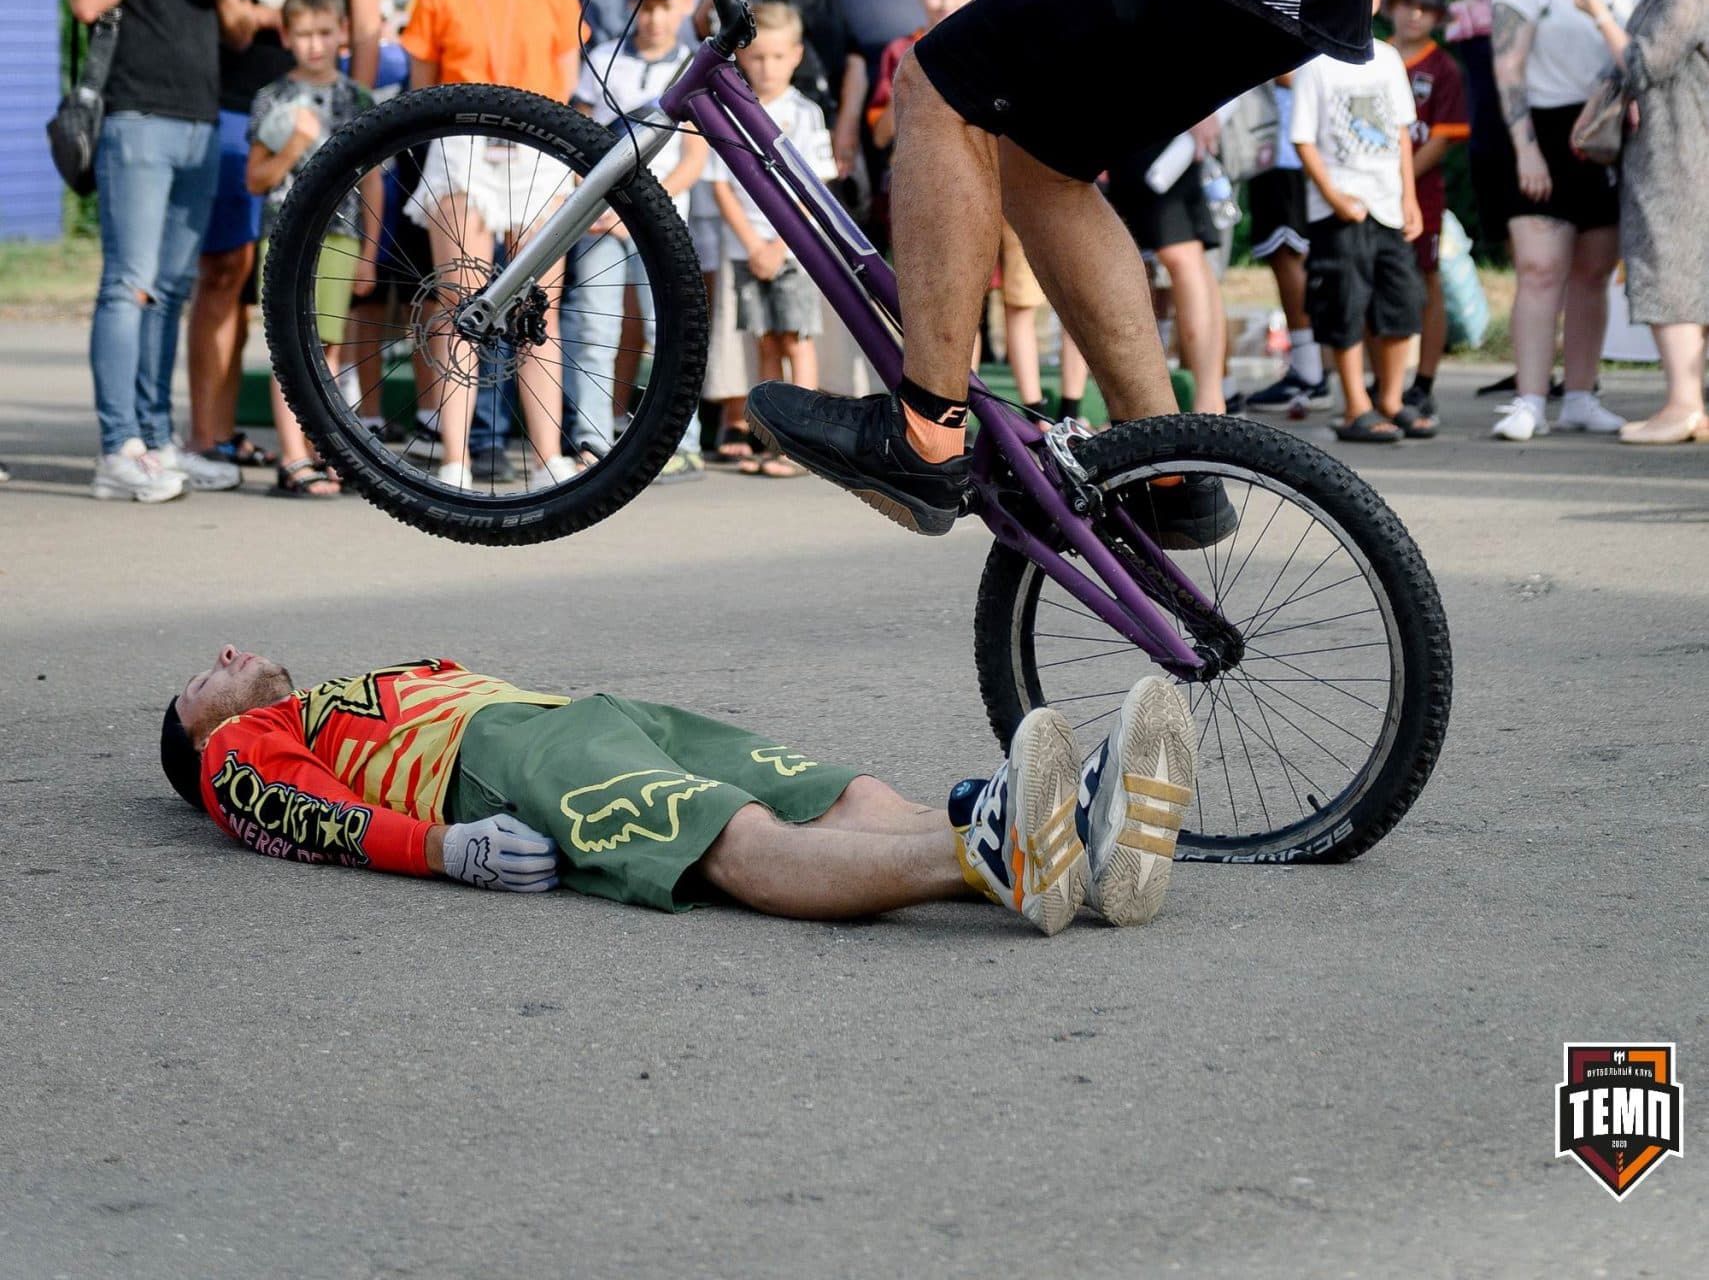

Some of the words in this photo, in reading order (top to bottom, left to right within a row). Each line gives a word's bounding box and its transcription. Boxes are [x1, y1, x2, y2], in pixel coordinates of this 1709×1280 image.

[456, 112, 593, 169] SCHWAL
[327, 431, 418, 505] SMART
[423, 505, 495, 529] SAM
[219, 803, 293, 859] NERGY
